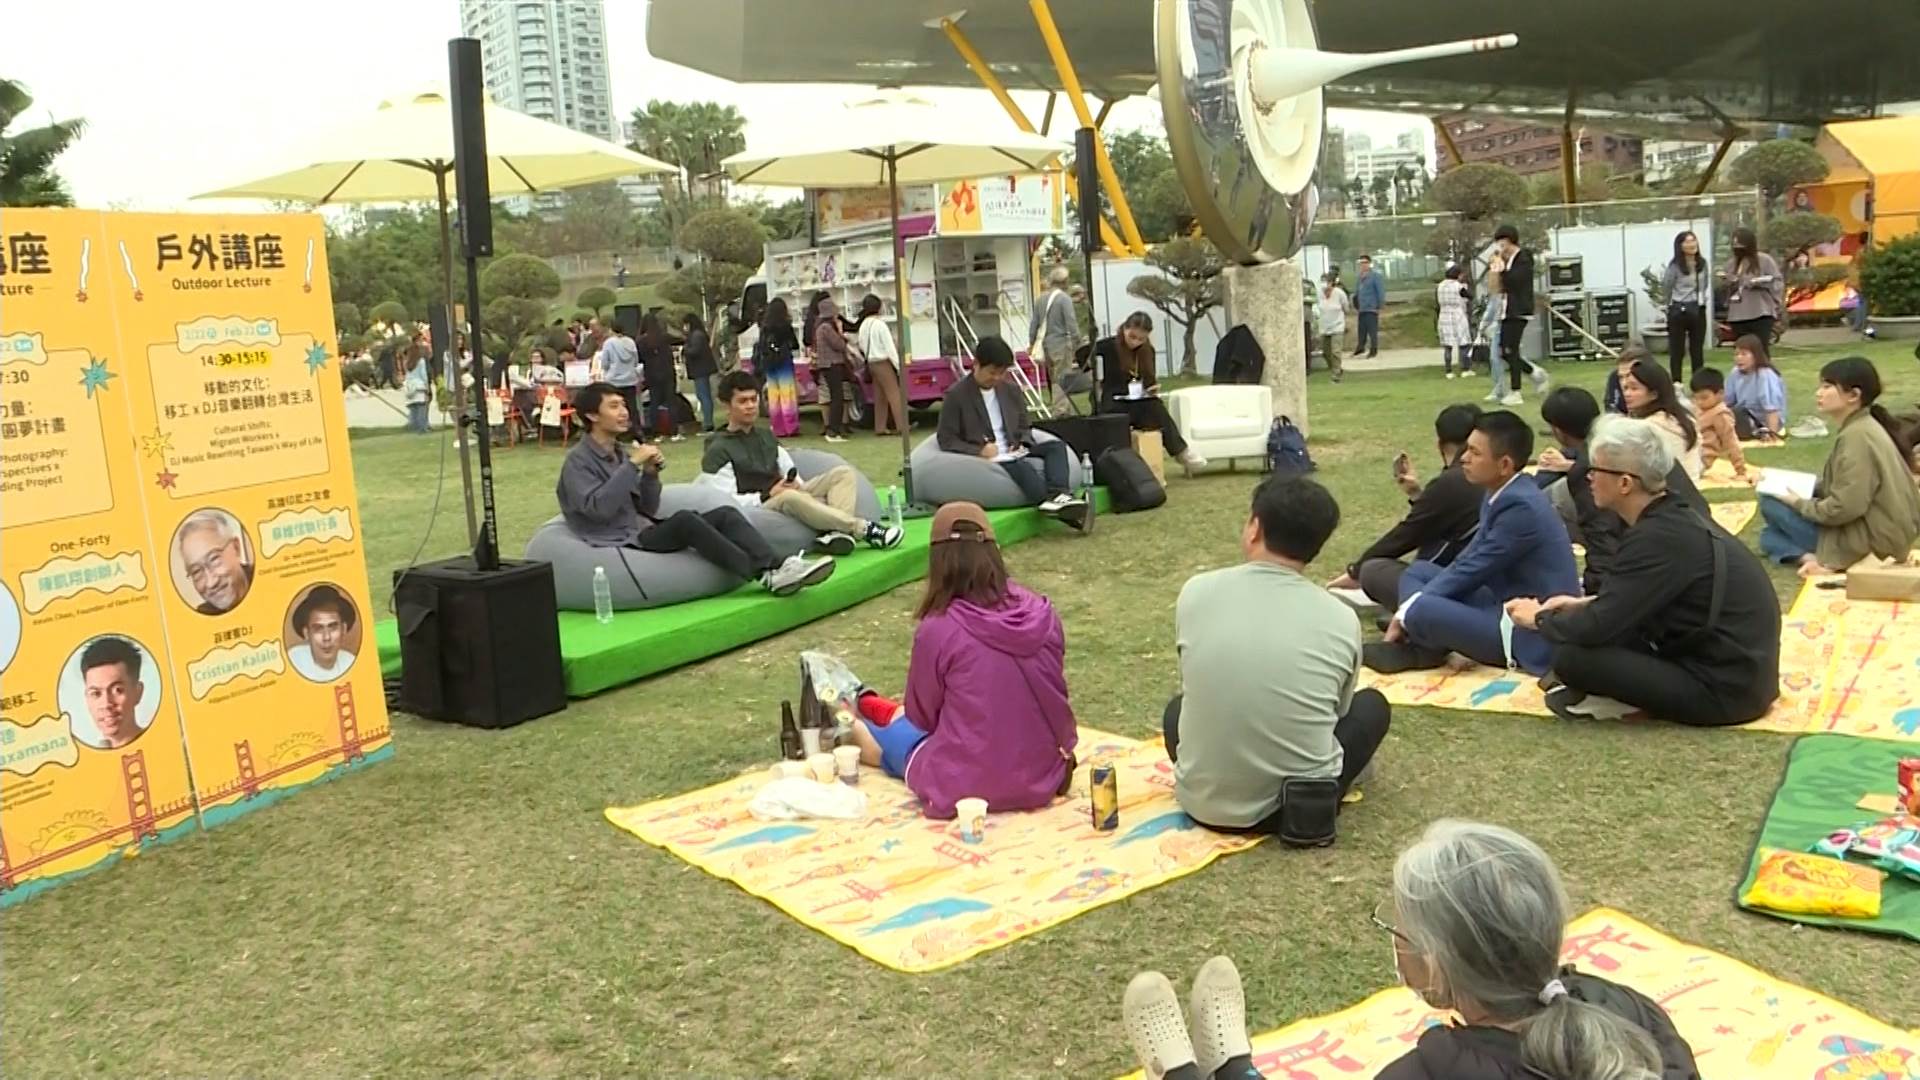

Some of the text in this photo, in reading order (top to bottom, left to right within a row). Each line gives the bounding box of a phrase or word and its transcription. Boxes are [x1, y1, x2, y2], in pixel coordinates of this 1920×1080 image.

[0, 231, 52, 276] 座
[157, 233, 286, 272] 戶外講座
[172, 276, 272, 290] Outdoor Lecture
[201, 351, 267, 367] 14:30-15:15
[214, 423, 246, 435] Cultural
[210, 437, 240, 448] Migrant
[242, 433, 274, 443] Workers
[182, 454, 205, 464] Music
[206, 447, 245, 460] Rewriting
[281, 440, 298, 450] Way
[308, 436, 322, 445] Life
[26, 475, 63, 488] Project
[50, 534, 111, 553] One-Forty
[194, 648, 278, 682] Cristian Kalalo
